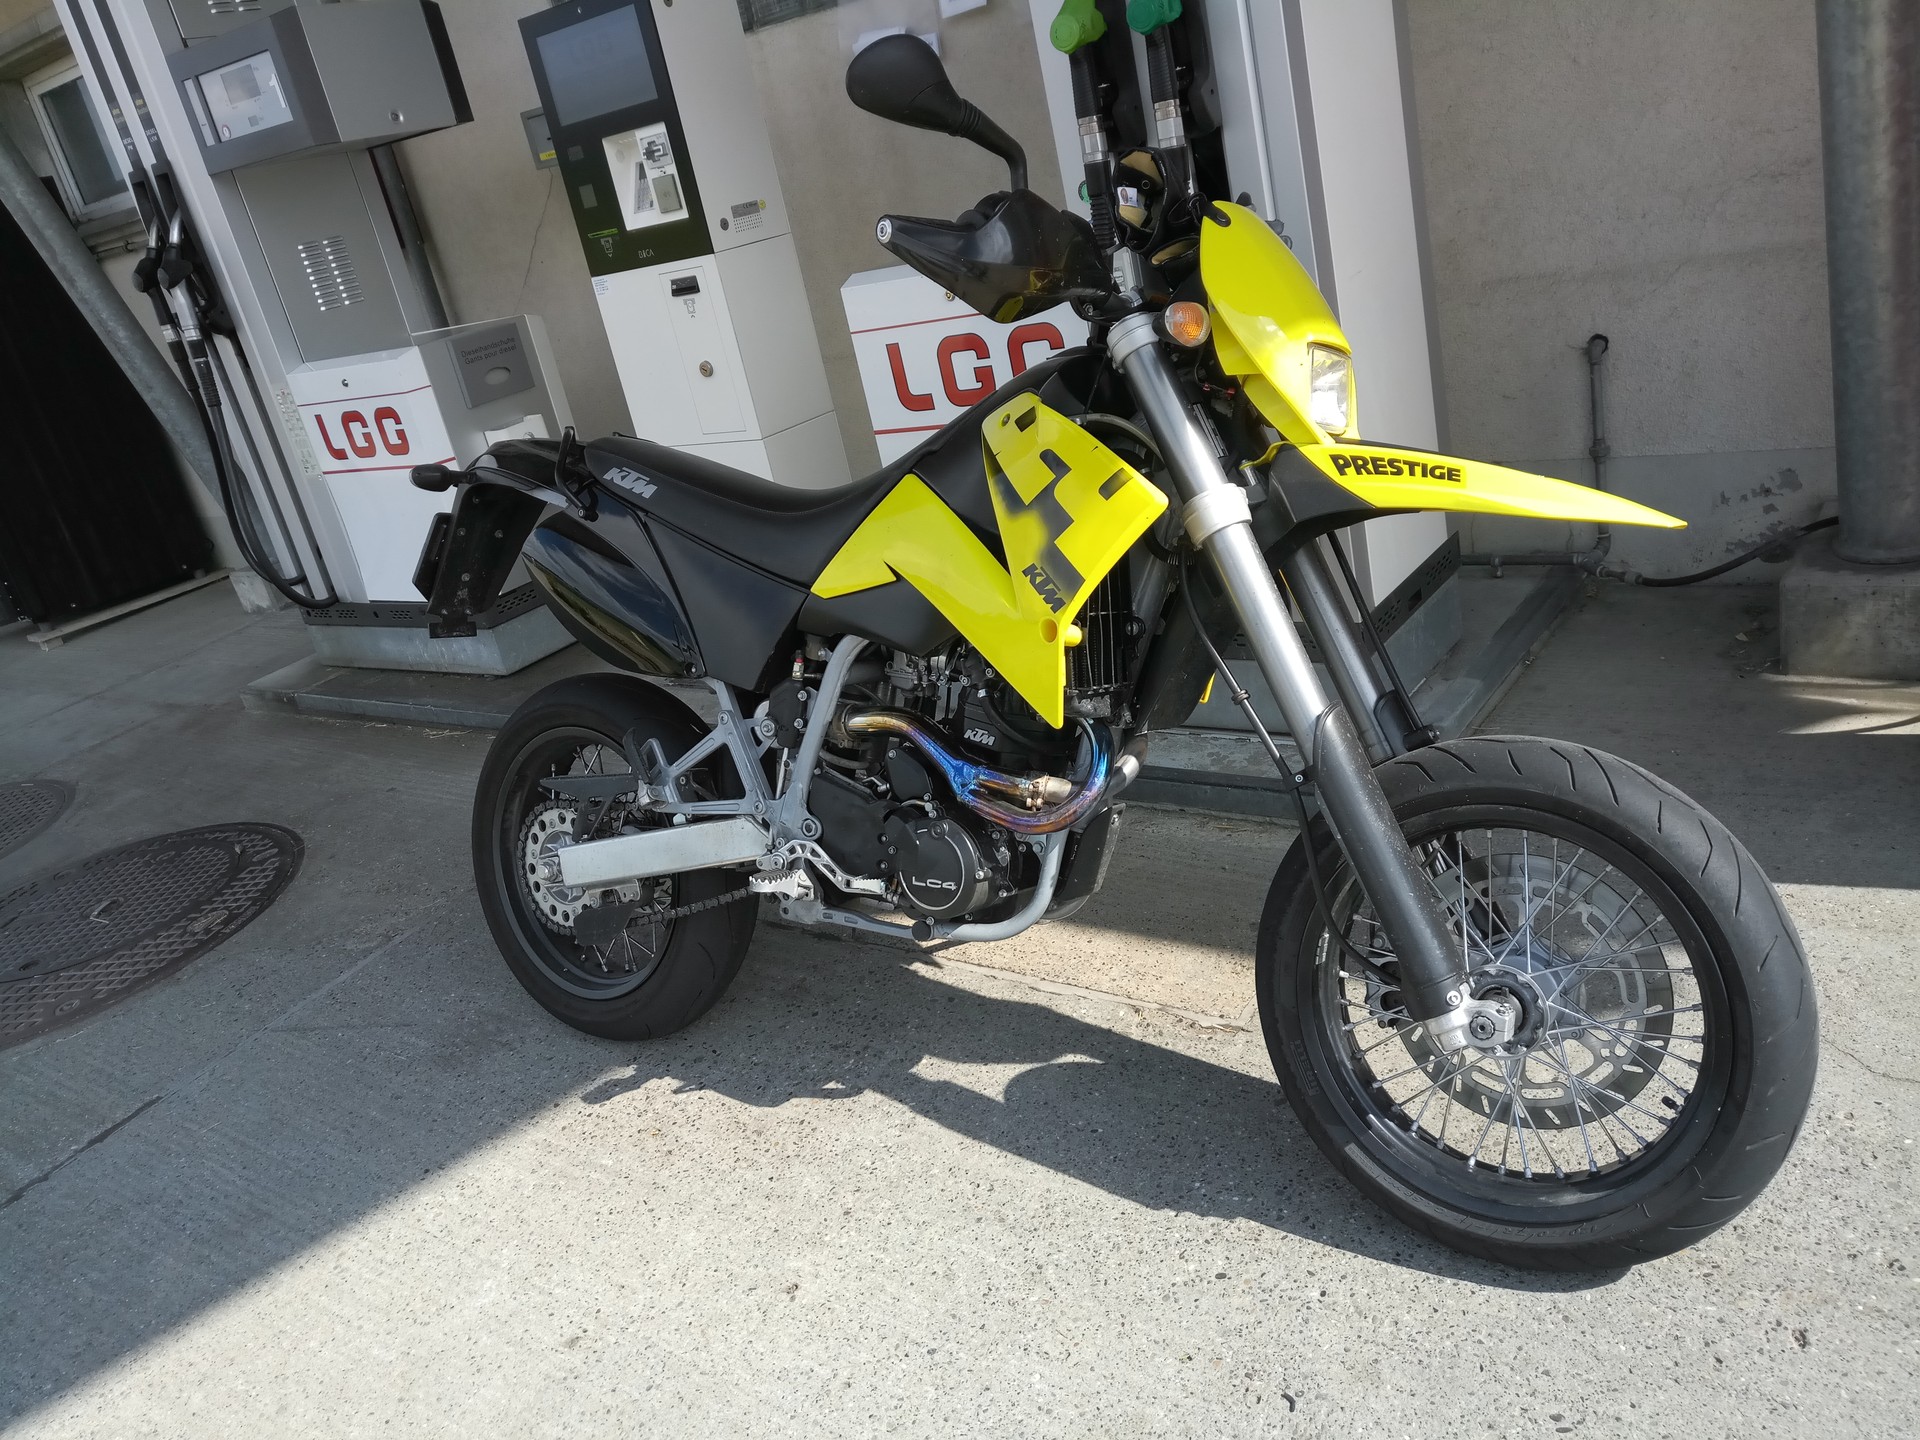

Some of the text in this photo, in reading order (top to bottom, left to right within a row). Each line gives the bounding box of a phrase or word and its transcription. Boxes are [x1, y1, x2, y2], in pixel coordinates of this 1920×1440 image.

[269, 73, 287, 108] 1
[464, 344, 517, 364] Gants pour diesel
[314, 406, 410, 460] LGG
[603, 467, 658, 499] KTM
[1329, 454, 1461, 482] PRESTIGE
[1022, 563, 1066, 614] KTM
[964, 728, 995, 746] KTM
[912, 876, 957, 891] LC4
